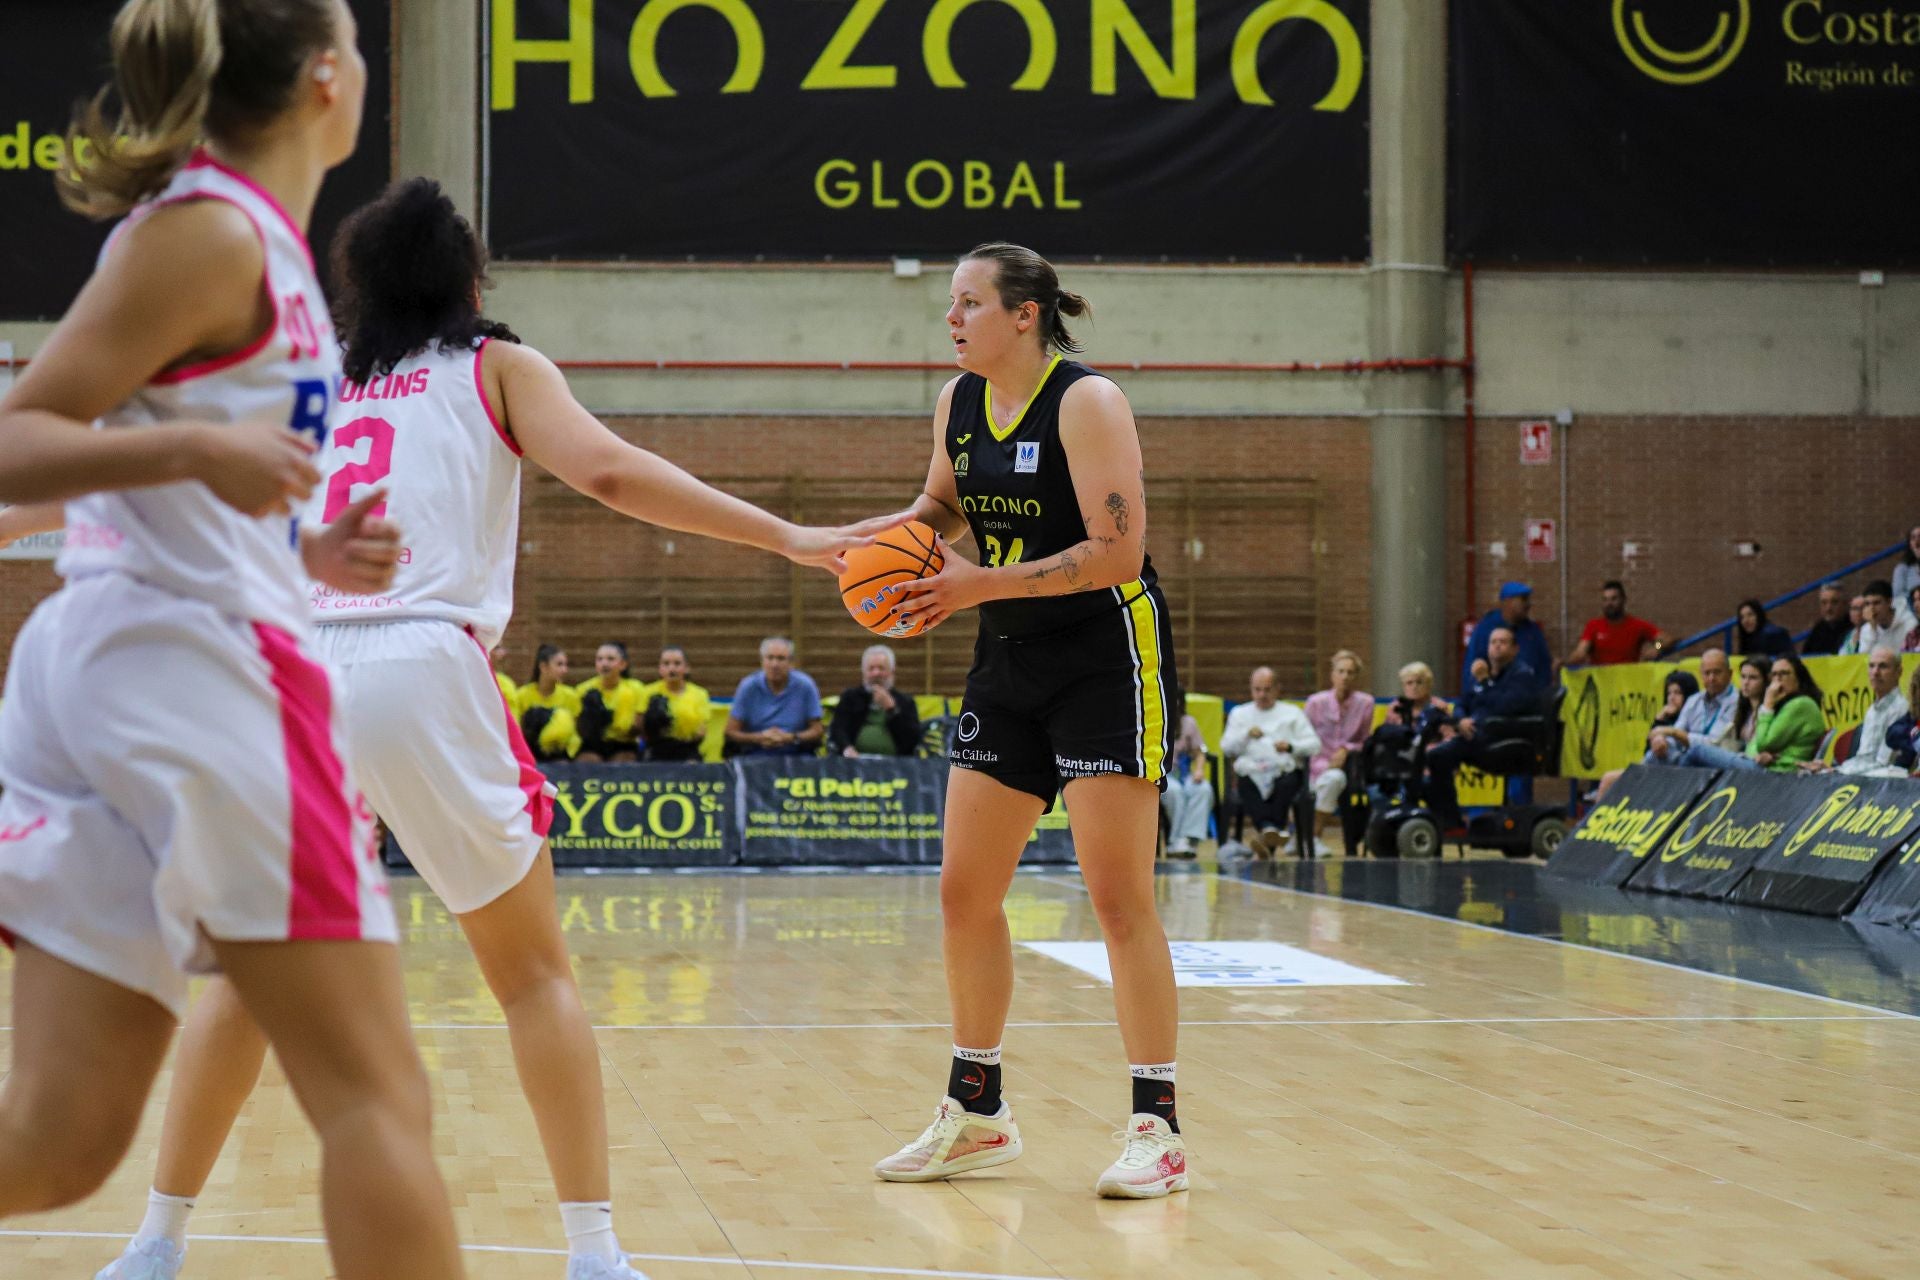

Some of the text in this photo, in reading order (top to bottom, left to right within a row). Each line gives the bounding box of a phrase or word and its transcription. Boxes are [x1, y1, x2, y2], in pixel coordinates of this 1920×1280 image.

[490, 0, 1364, 112] HOZONO
[1785, 60, 1915, 90] Región de
[814, 159, 1082, 210] GLOBAL
[323, 416, 396, 524] 2
[983, 520, 1013, 530] GLOBAL
[985, 534, 1024, 569] 34
[333, 596, 405, 609] GALICIA
[962, 748, 998, 762] Cálida
[582, 779, 727, 797] Construye
[1150, 1066, 1176, 1075] SPAL
